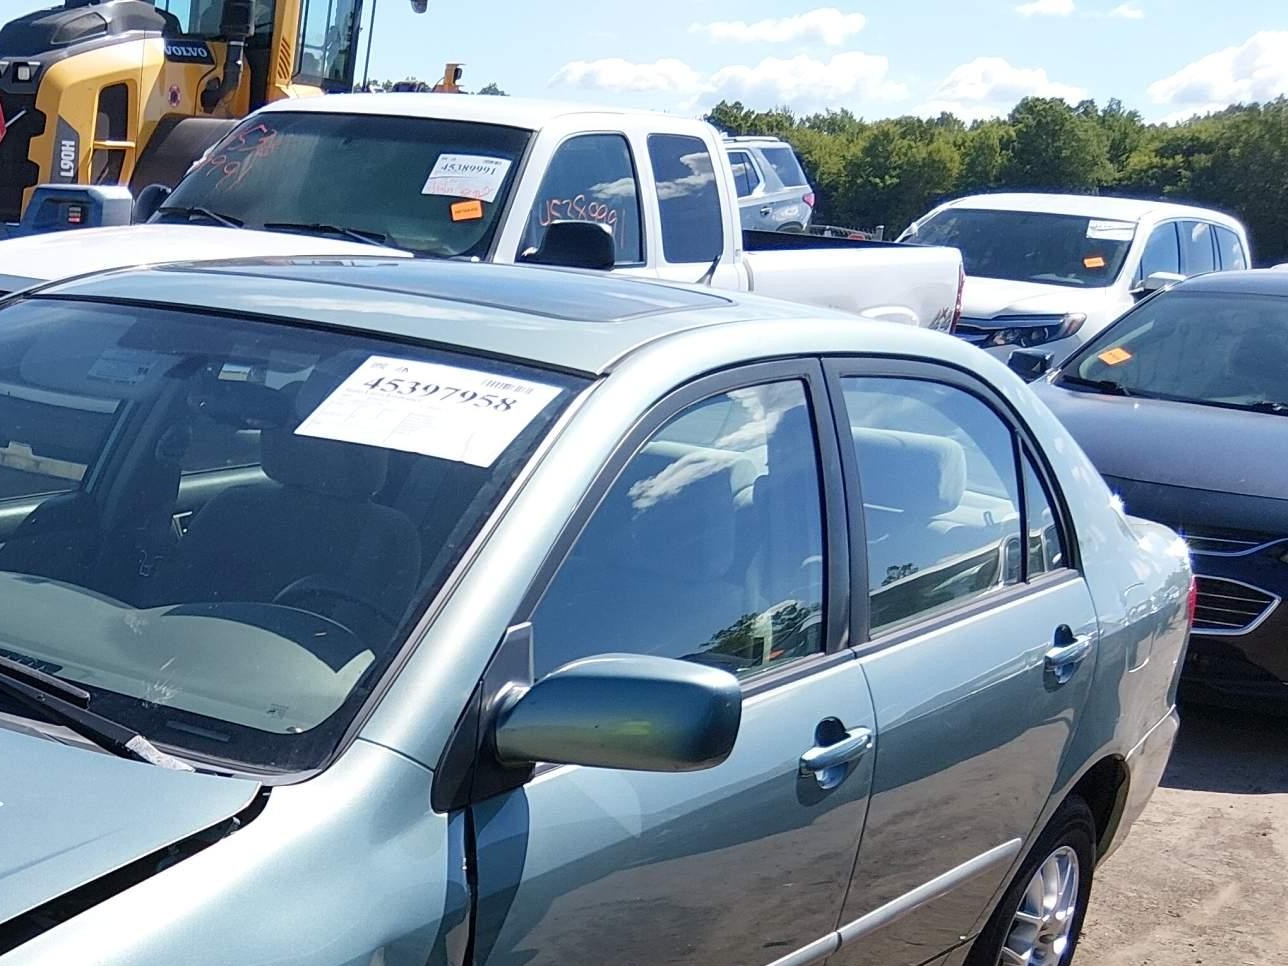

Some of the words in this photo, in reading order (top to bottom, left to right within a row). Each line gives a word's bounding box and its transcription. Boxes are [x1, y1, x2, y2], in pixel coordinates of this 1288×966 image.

[164, 45, 208, 58] VOLVO
[60, 140, 75, 177] L90H
[362, 375, 518, 412] 45397958
